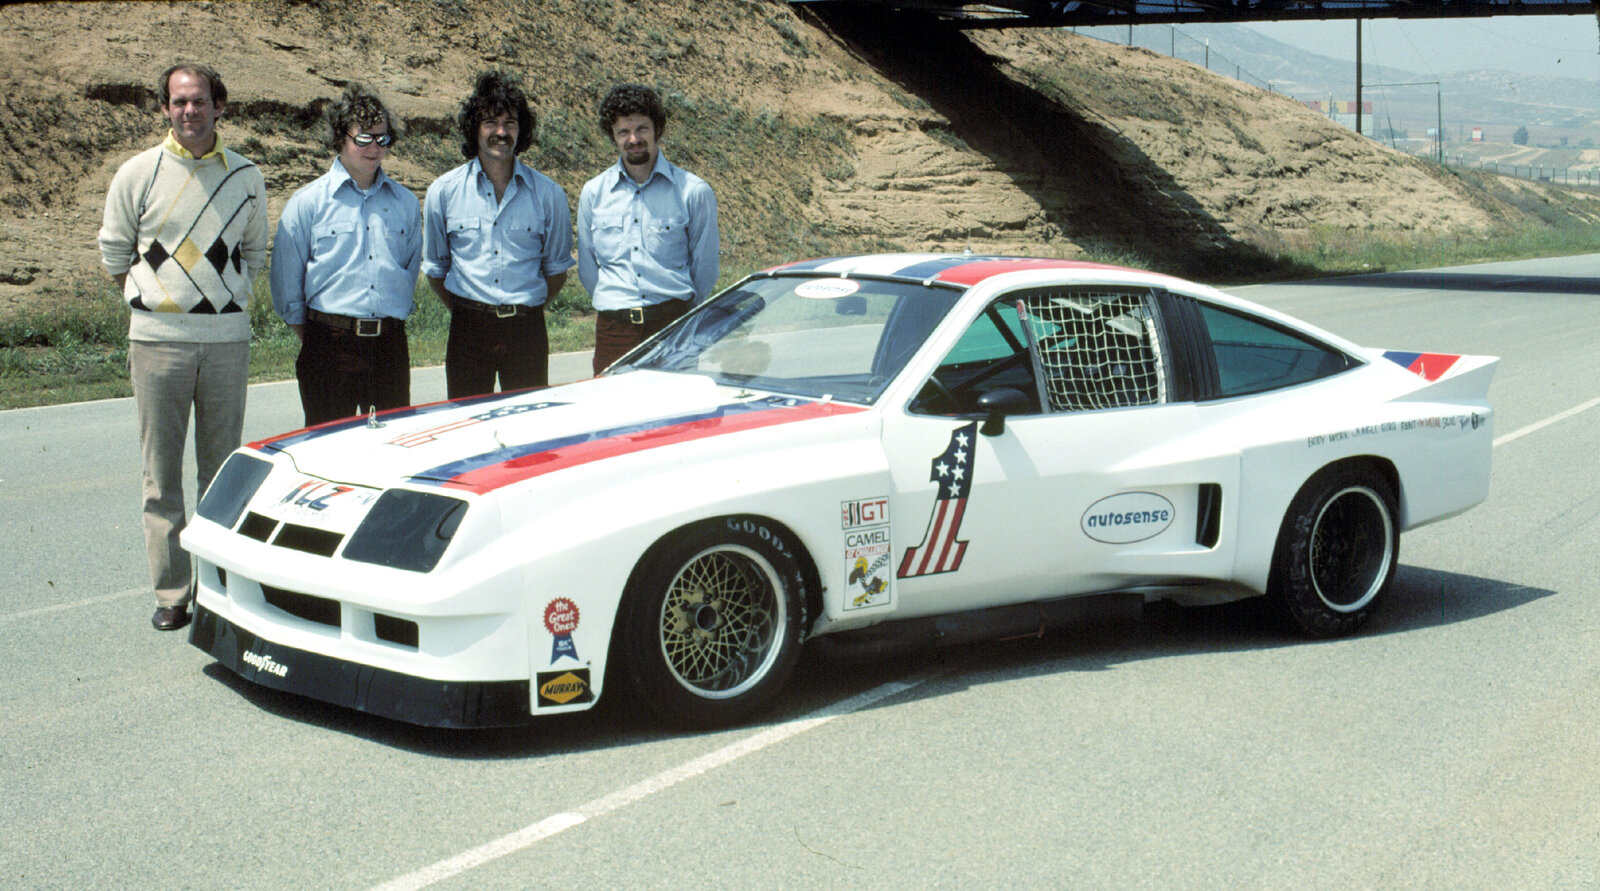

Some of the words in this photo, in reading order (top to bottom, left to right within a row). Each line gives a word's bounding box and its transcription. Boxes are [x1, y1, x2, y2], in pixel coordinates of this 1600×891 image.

[897, 420, 978, 579] 1
[861, 500, 888, 522] GT
[1087, 509, 1169, 528] autosense
[846, 531, 889, 548] CAMEL
[555, 601, 569, 612] the
[549, 611, 575, 624] Great
[553, 622, 576, 633] Ones
[243, 650, 288, 677] GOODYEAR
[544, 681, 584, 696] MURRAY
